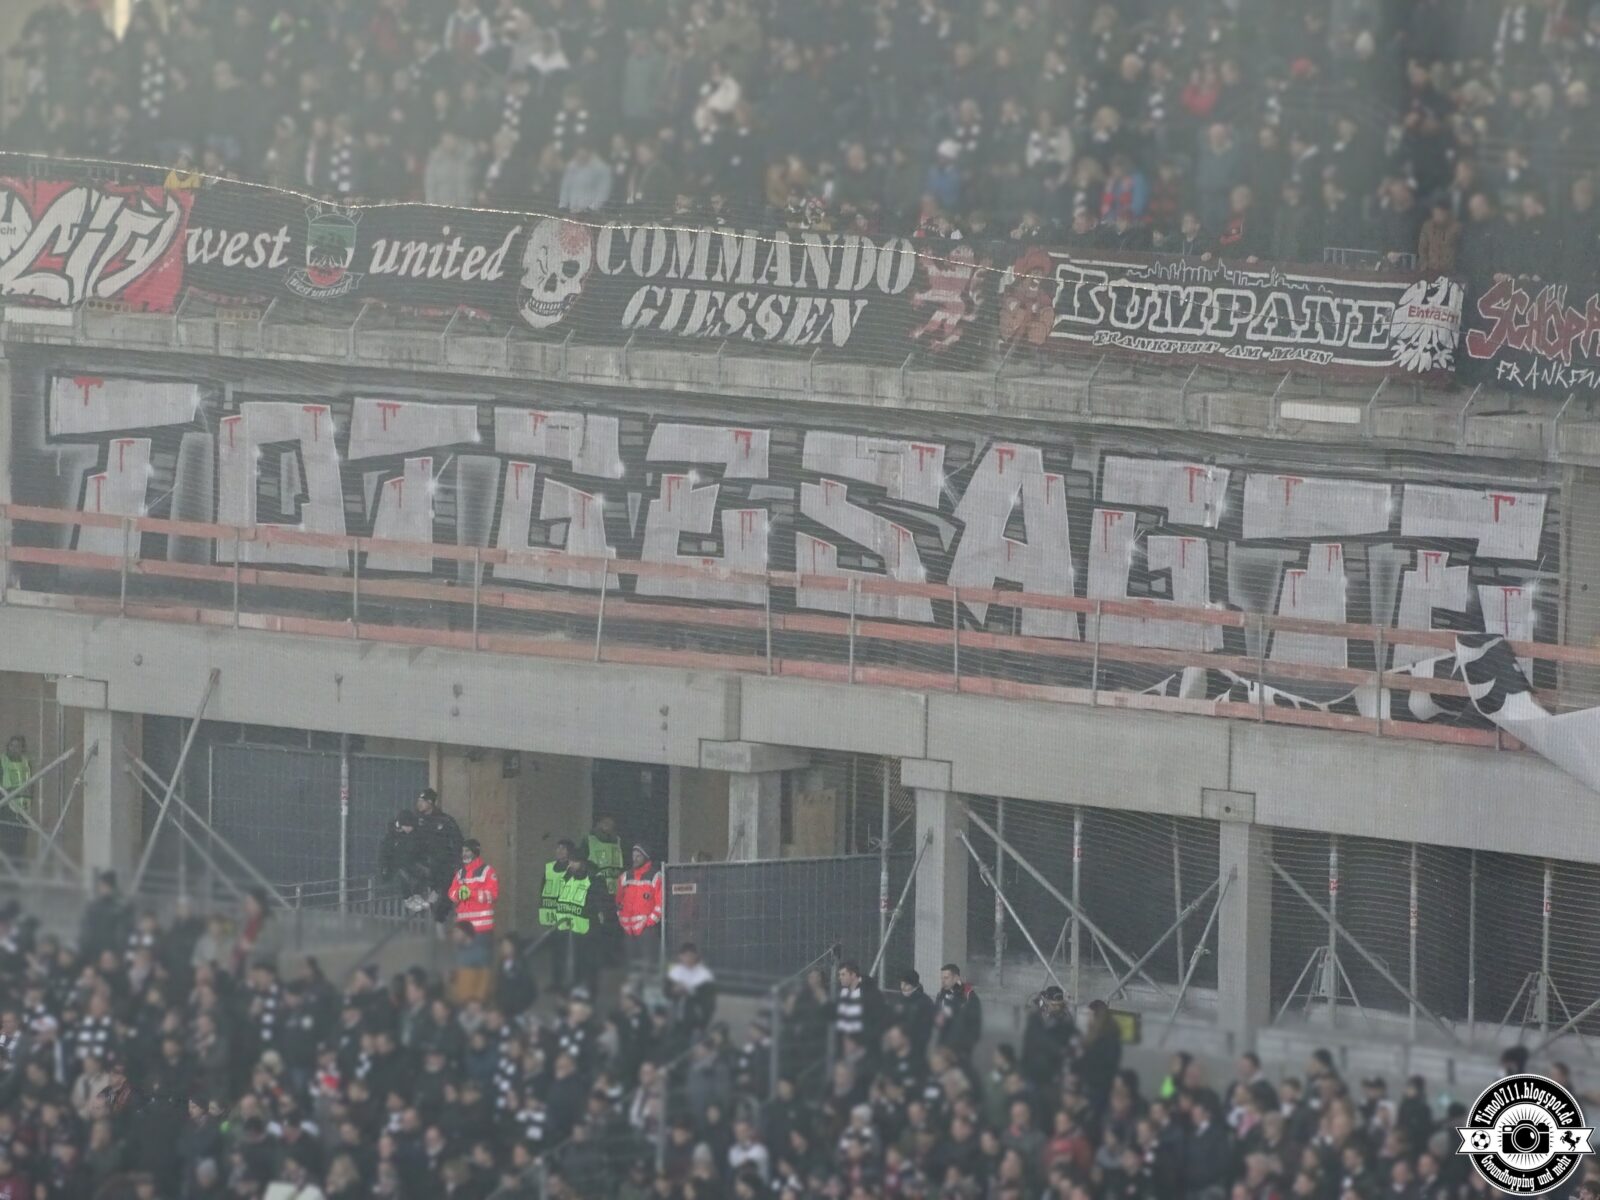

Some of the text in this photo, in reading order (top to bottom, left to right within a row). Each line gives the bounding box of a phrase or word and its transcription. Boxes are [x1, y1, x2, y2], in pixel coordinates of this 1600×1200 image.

[185, 225, 521, 281] west united
[597, 221, 916, 295] COMMANDO
[621, 285, 868, 348] GIESSEN
[1054, 264, 1396, 350] KUMPANE
[48, 376, 1547, 682] TOTGESAGTE
